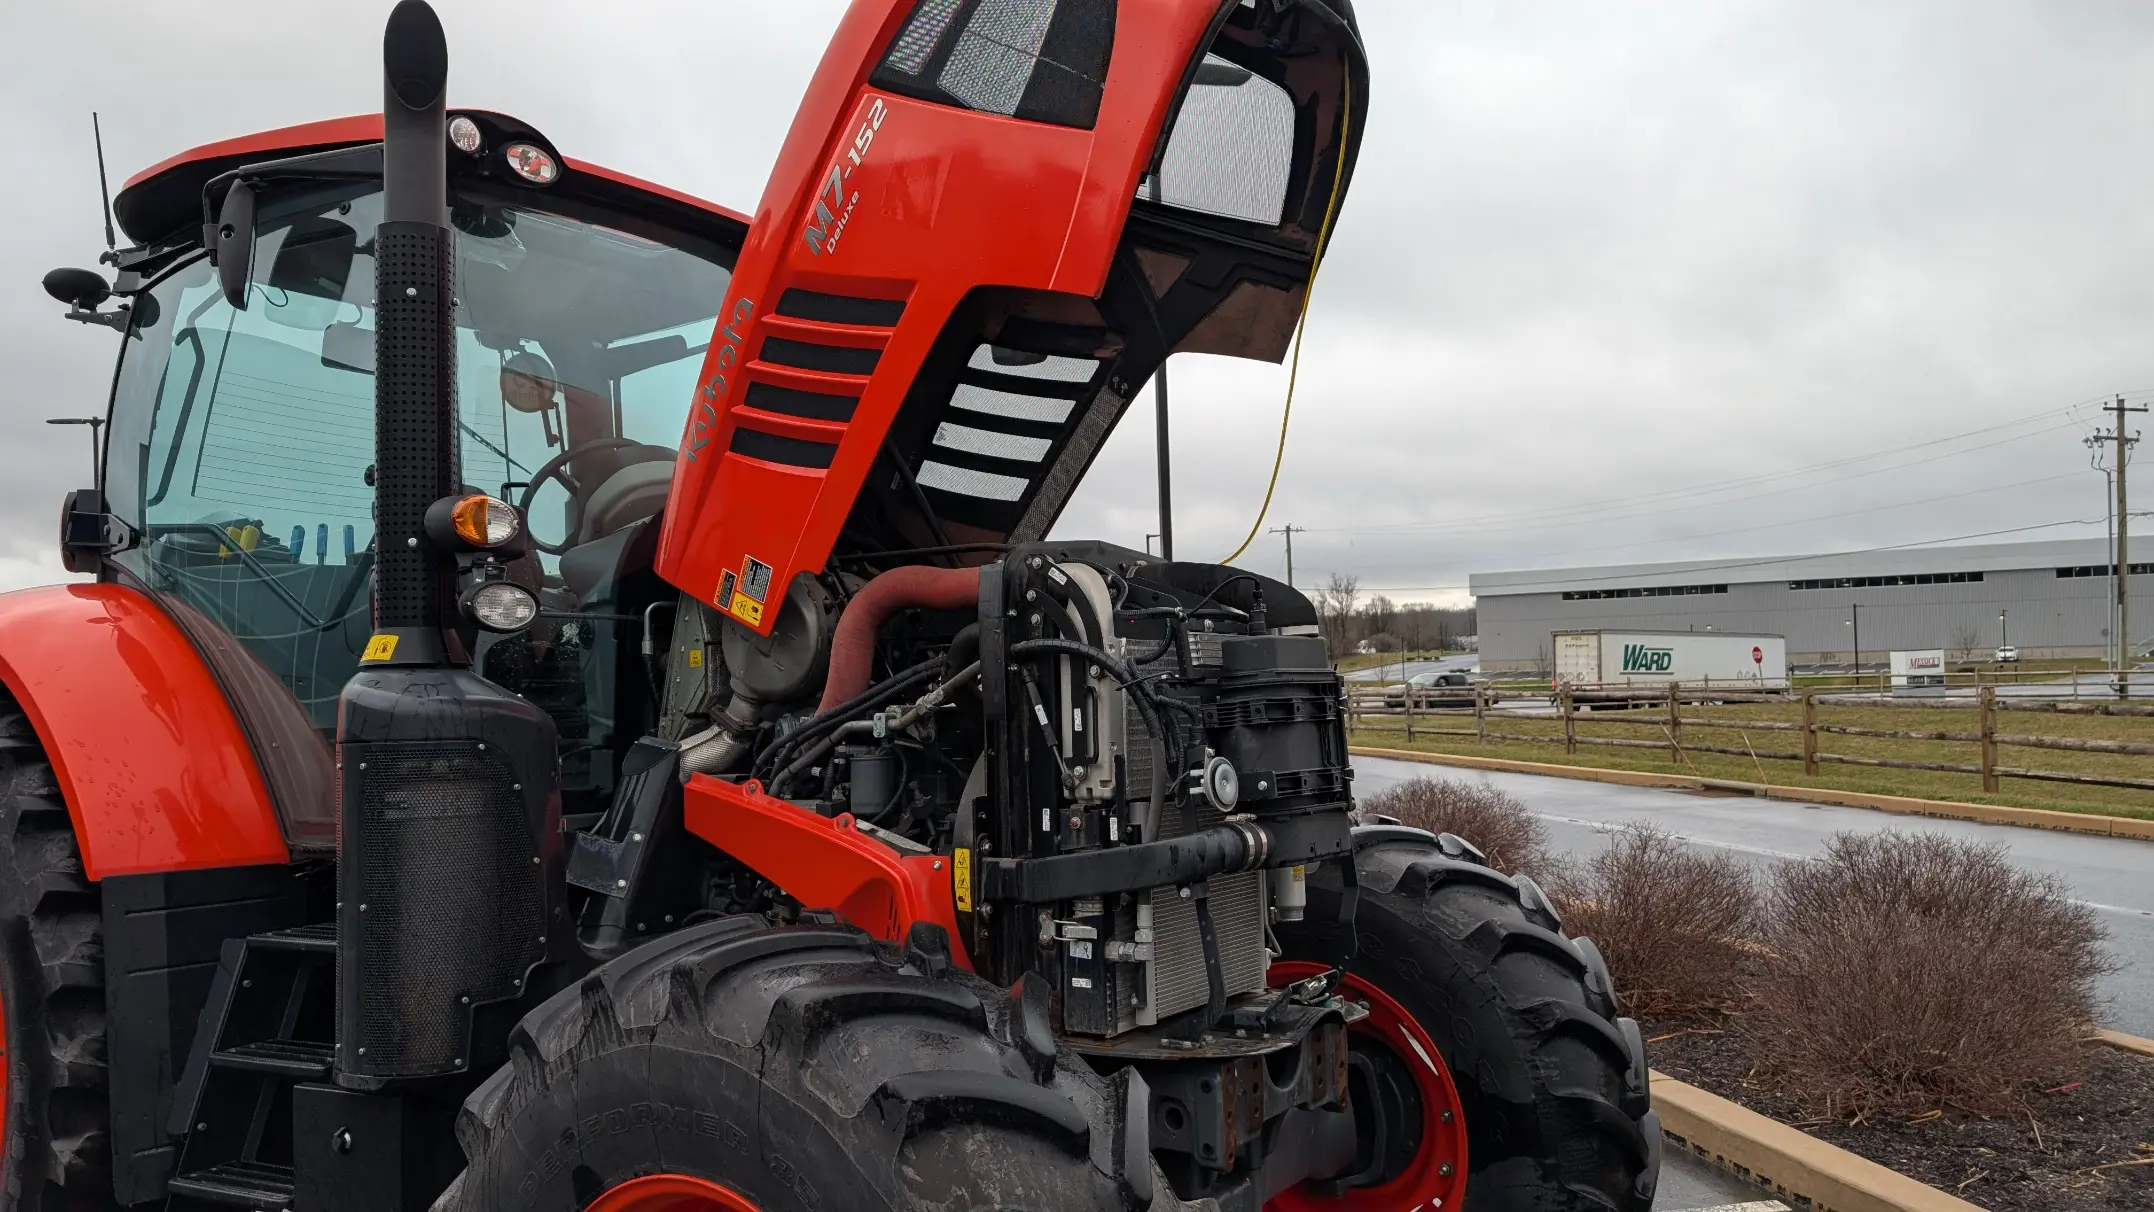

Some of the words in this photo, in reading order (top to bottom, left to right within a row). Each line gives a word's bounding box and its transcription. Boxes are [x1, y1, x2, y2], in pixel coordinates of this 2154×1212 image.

[804, 98, 888, 257] M7-152
[827, 190, 860, 255] Deluxe
[684, 297, 755, 463] Kubota
[1622, 643, 1672, 671] WARD
[516, 1100, 751, 1208] PERFORMER
